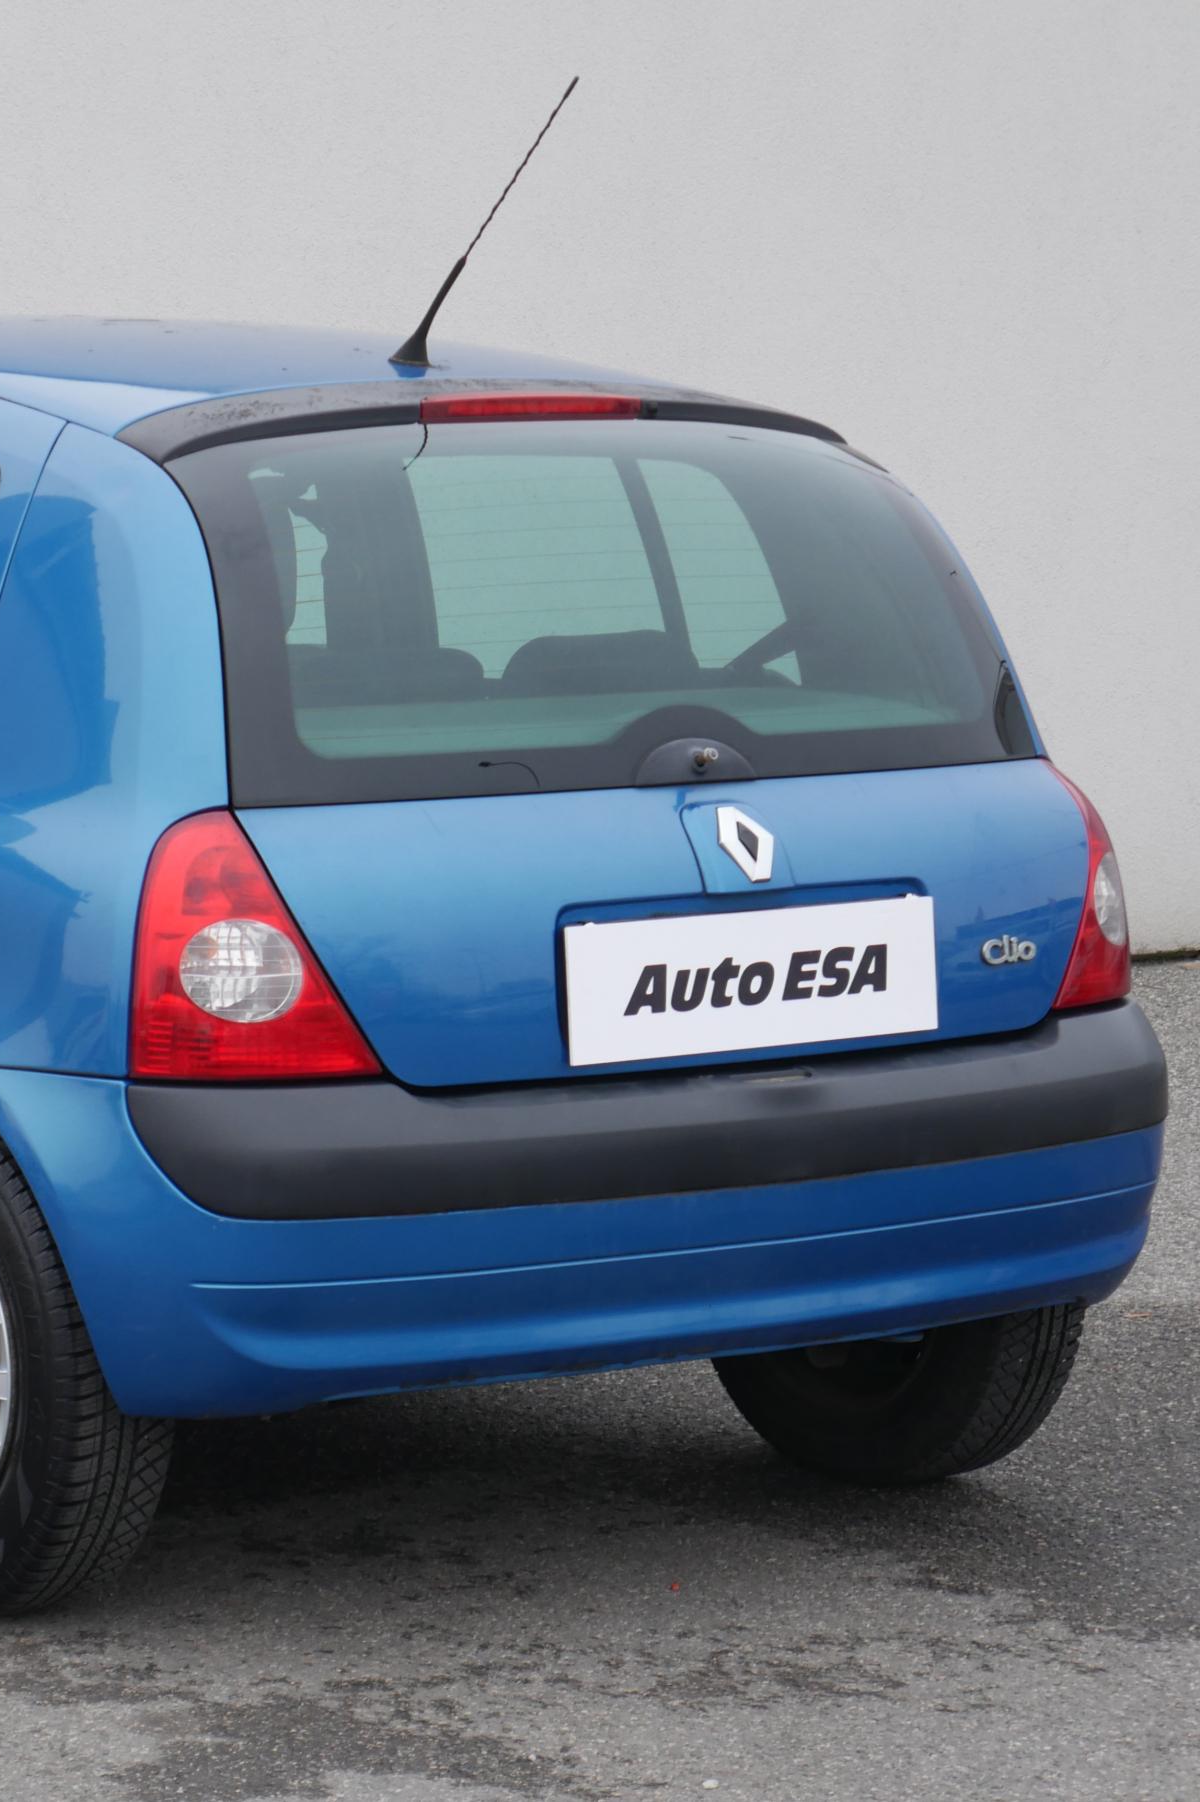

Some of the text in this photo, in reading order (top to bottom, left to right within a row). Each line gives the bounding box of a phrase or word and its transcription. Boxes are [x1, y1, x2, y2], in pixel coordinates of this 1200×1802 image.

[981, 934, 1037, 965] Clio
[623, 943, 888, 1016] Auto ESA
